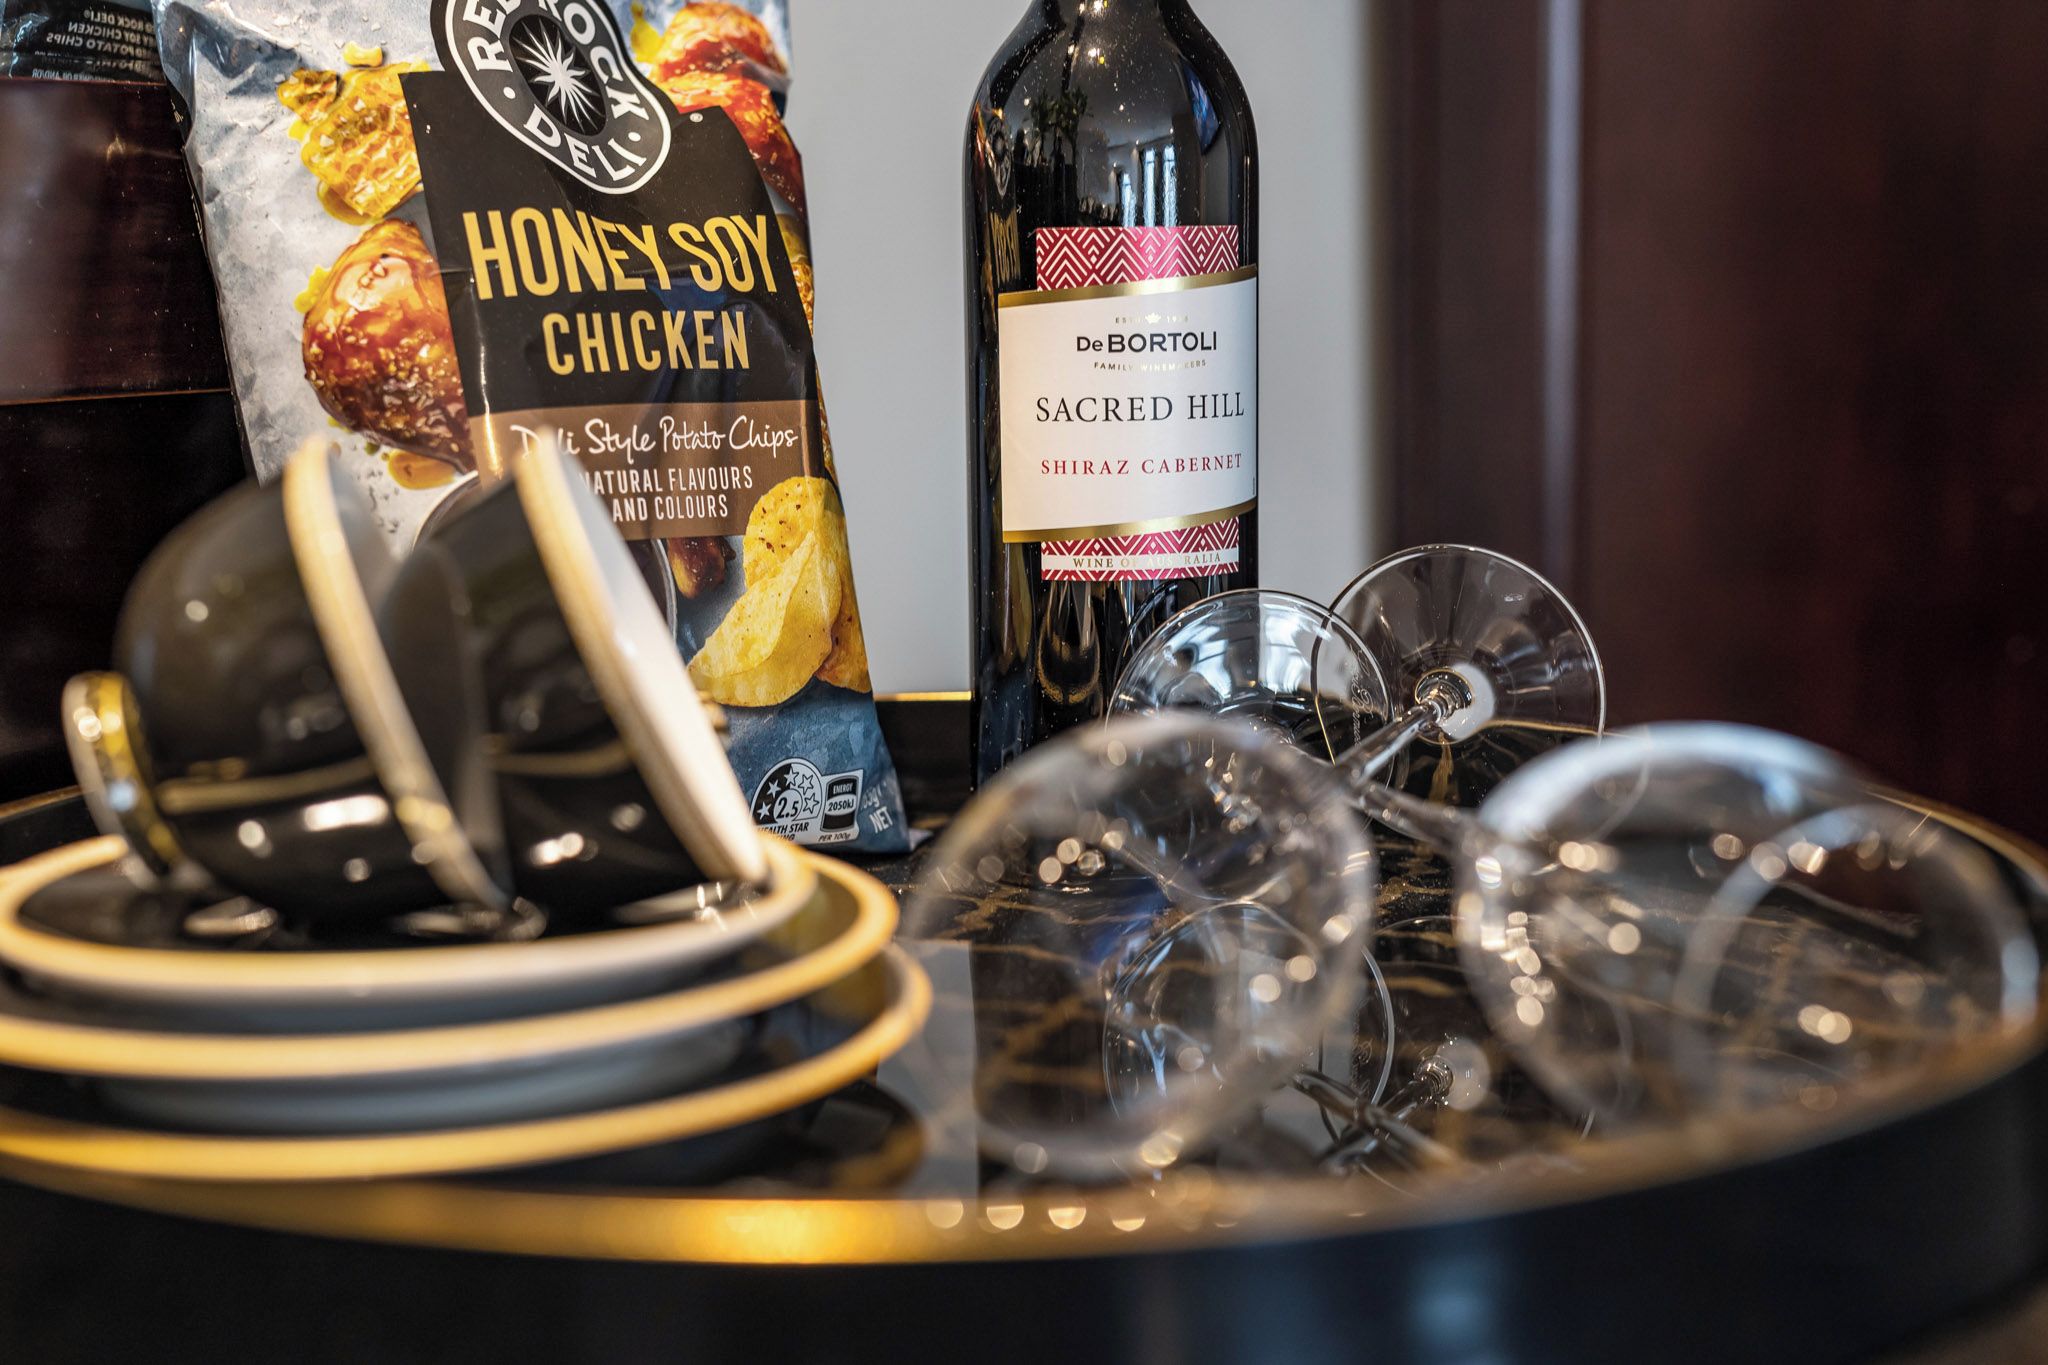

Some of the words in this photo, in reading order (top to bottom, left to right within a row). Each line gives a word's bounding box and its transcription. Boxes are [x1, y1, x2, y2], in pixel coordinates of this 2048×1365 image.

[463, 0, 521, 73] RE
[524, 104, 647, 181] DELI
[462, 207, 672, 300] HONEY
[668, 214, 777, 293] SOY
[542, 310, 750, 376] CHICKEN
[1107, 331, 1217, 353] BORTOLI
[1094, 361, 1134, 371] FAMILY
[1140, 359, 1206, 371] WINEMKERS
[1036, 396, 1173, 422] SACRED
[1187, 392, 1245, 420] HILL
[510, 424, 580, 459] Dli
[584, 418, 656, 464] Style
[659, 415, 725, 452] Potato
[729, 415, 798, 458] Chips
[1041, 459, 1130, 475] SHIRAZ
[1141, 453, 1242, 474] CABERNET
[668, 466, 753, 491] FLAVOURS
[613, 497, 648, 522] AND
[655, 494, 728, 520] COLOURS
[1073, 558, 1114, 568] WINE
[1147, 552, 1221, 567] AUSRALIA
[833, 782, 853, 795] ENERGY
[776, 797, 799, 819] 2.5
[869, 806, 893, 834] NET
[758, 825, 788, 835] EALTH
[789, 821, 809, 833] STAR
[818, 833, 832, 842] PER
